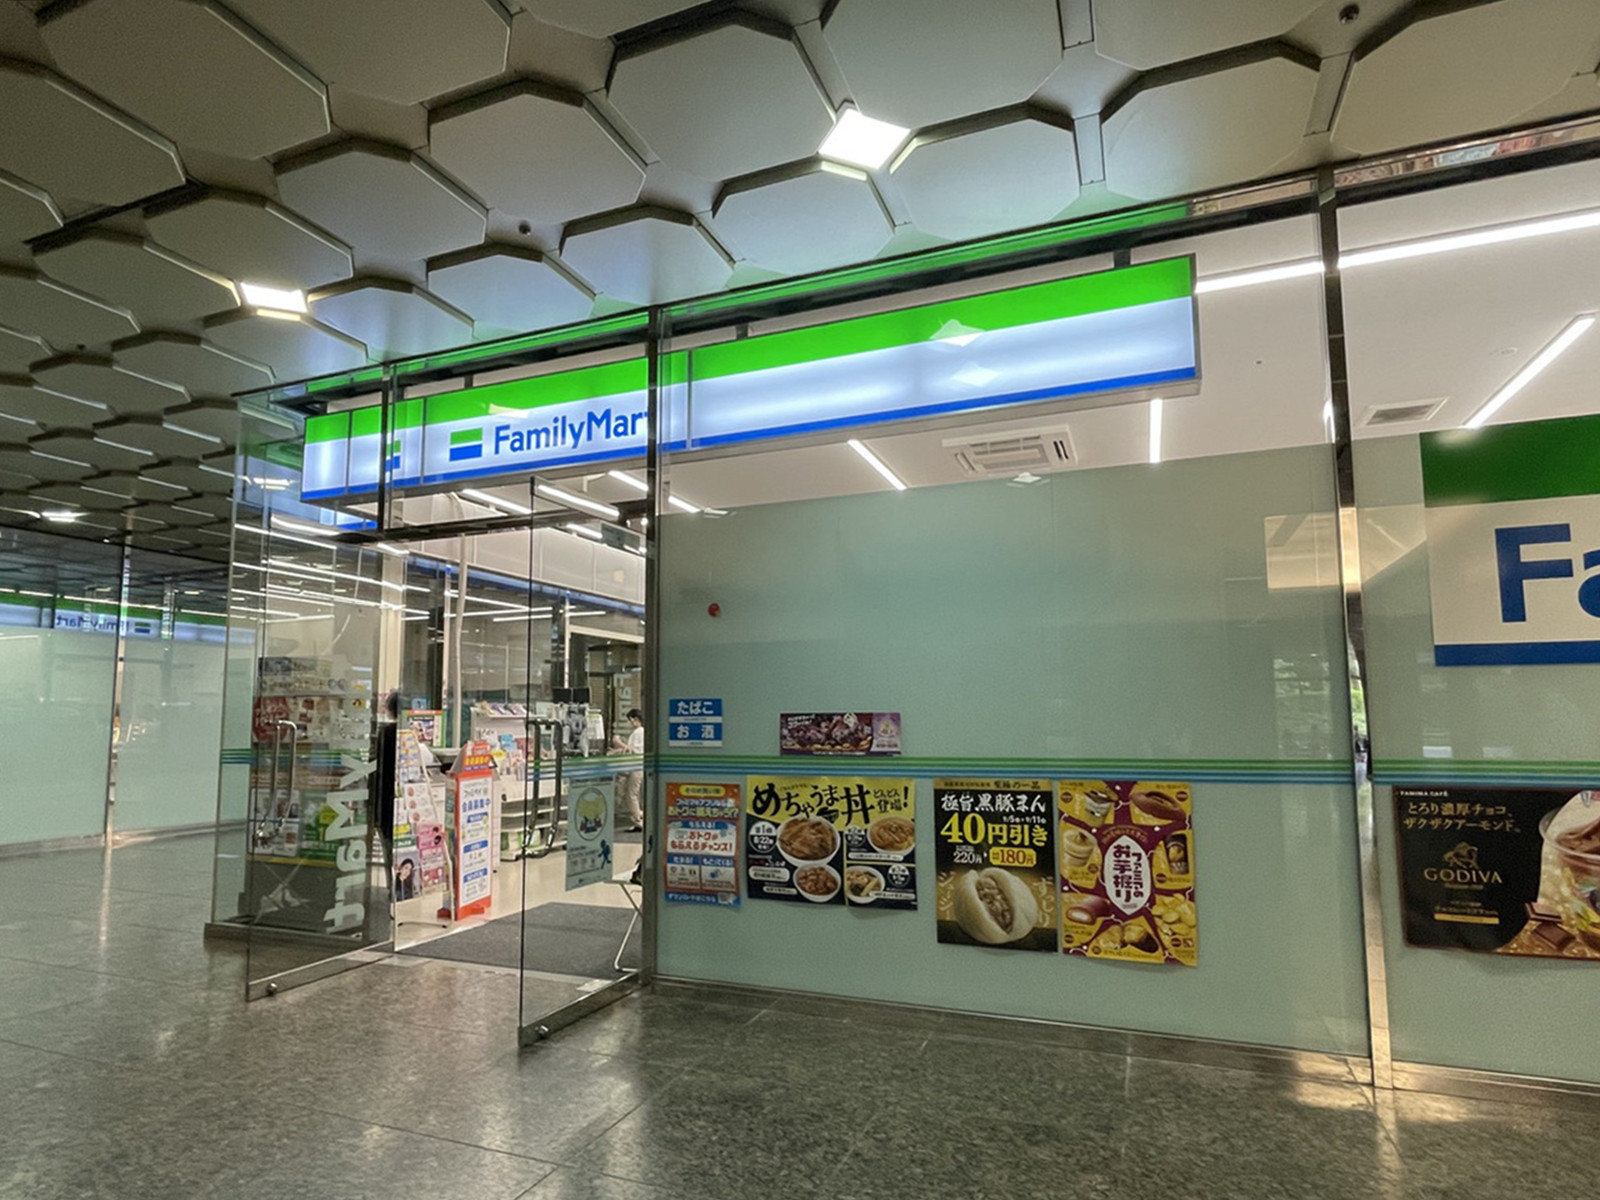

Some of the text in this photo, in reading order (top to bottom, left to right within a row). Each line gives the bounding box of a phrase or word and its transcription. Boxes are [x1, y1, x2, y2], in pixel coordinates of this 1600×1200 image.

[677, 701, 714, 715] たばこ
[941, 793, 1046, 812] 極旨黒豚まん
[1424, 867, 1503, 884] GODIVA
